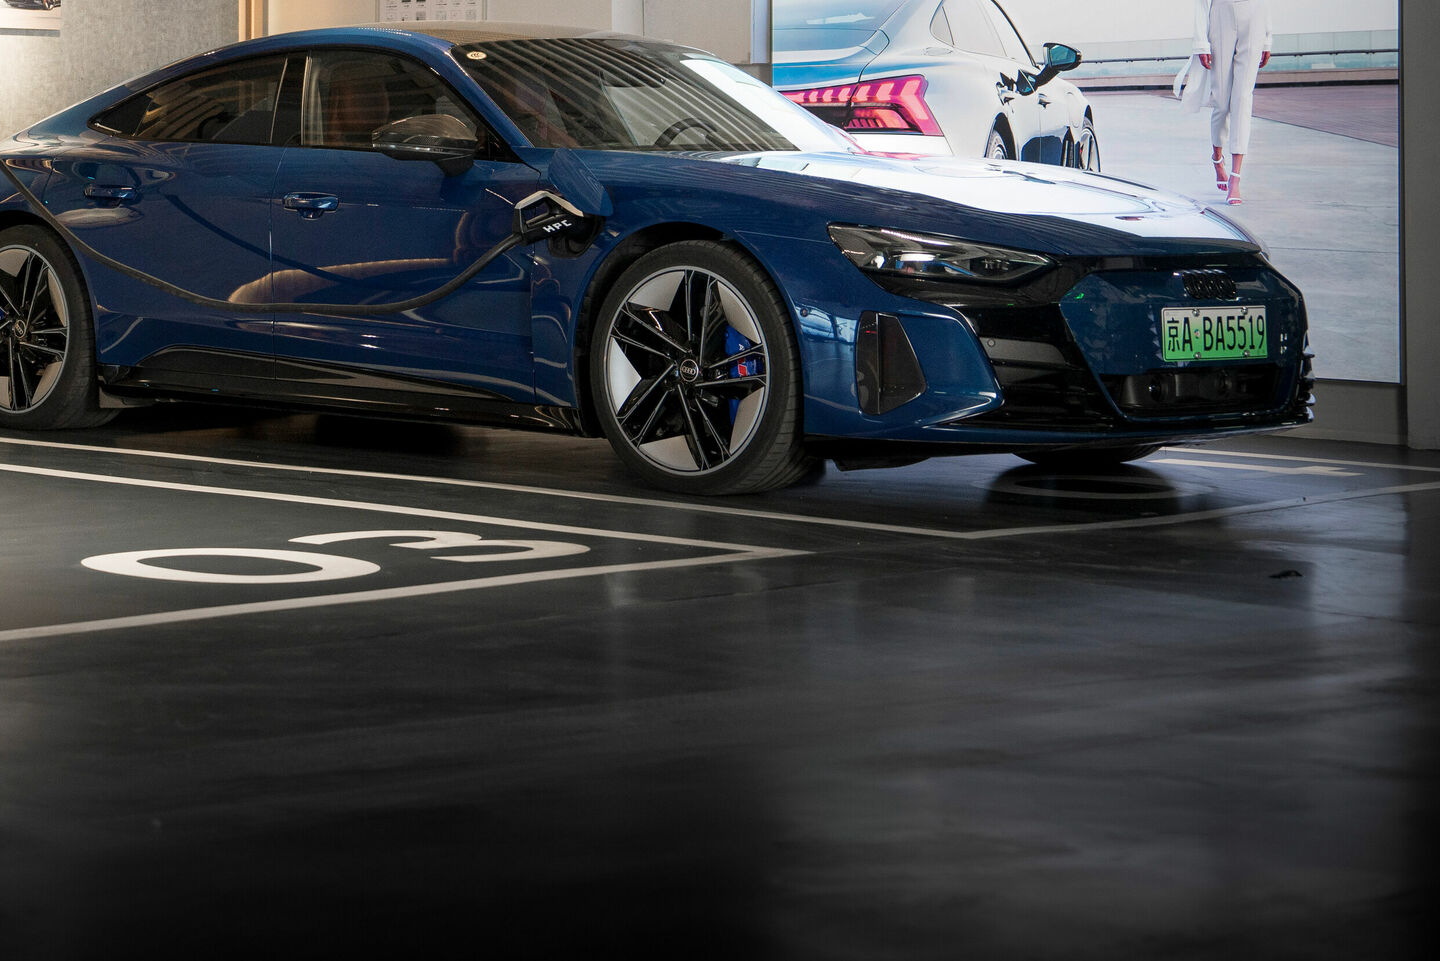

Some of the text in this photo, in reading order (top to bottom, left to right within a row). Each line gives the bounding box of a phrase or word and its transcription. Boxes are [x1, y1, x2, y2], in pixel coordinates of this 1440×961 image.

[542, 219, 573, 233] HPC
[1167, 315, 1265, 352] 京A BA5519
[80, 529, 592, 585] 03
